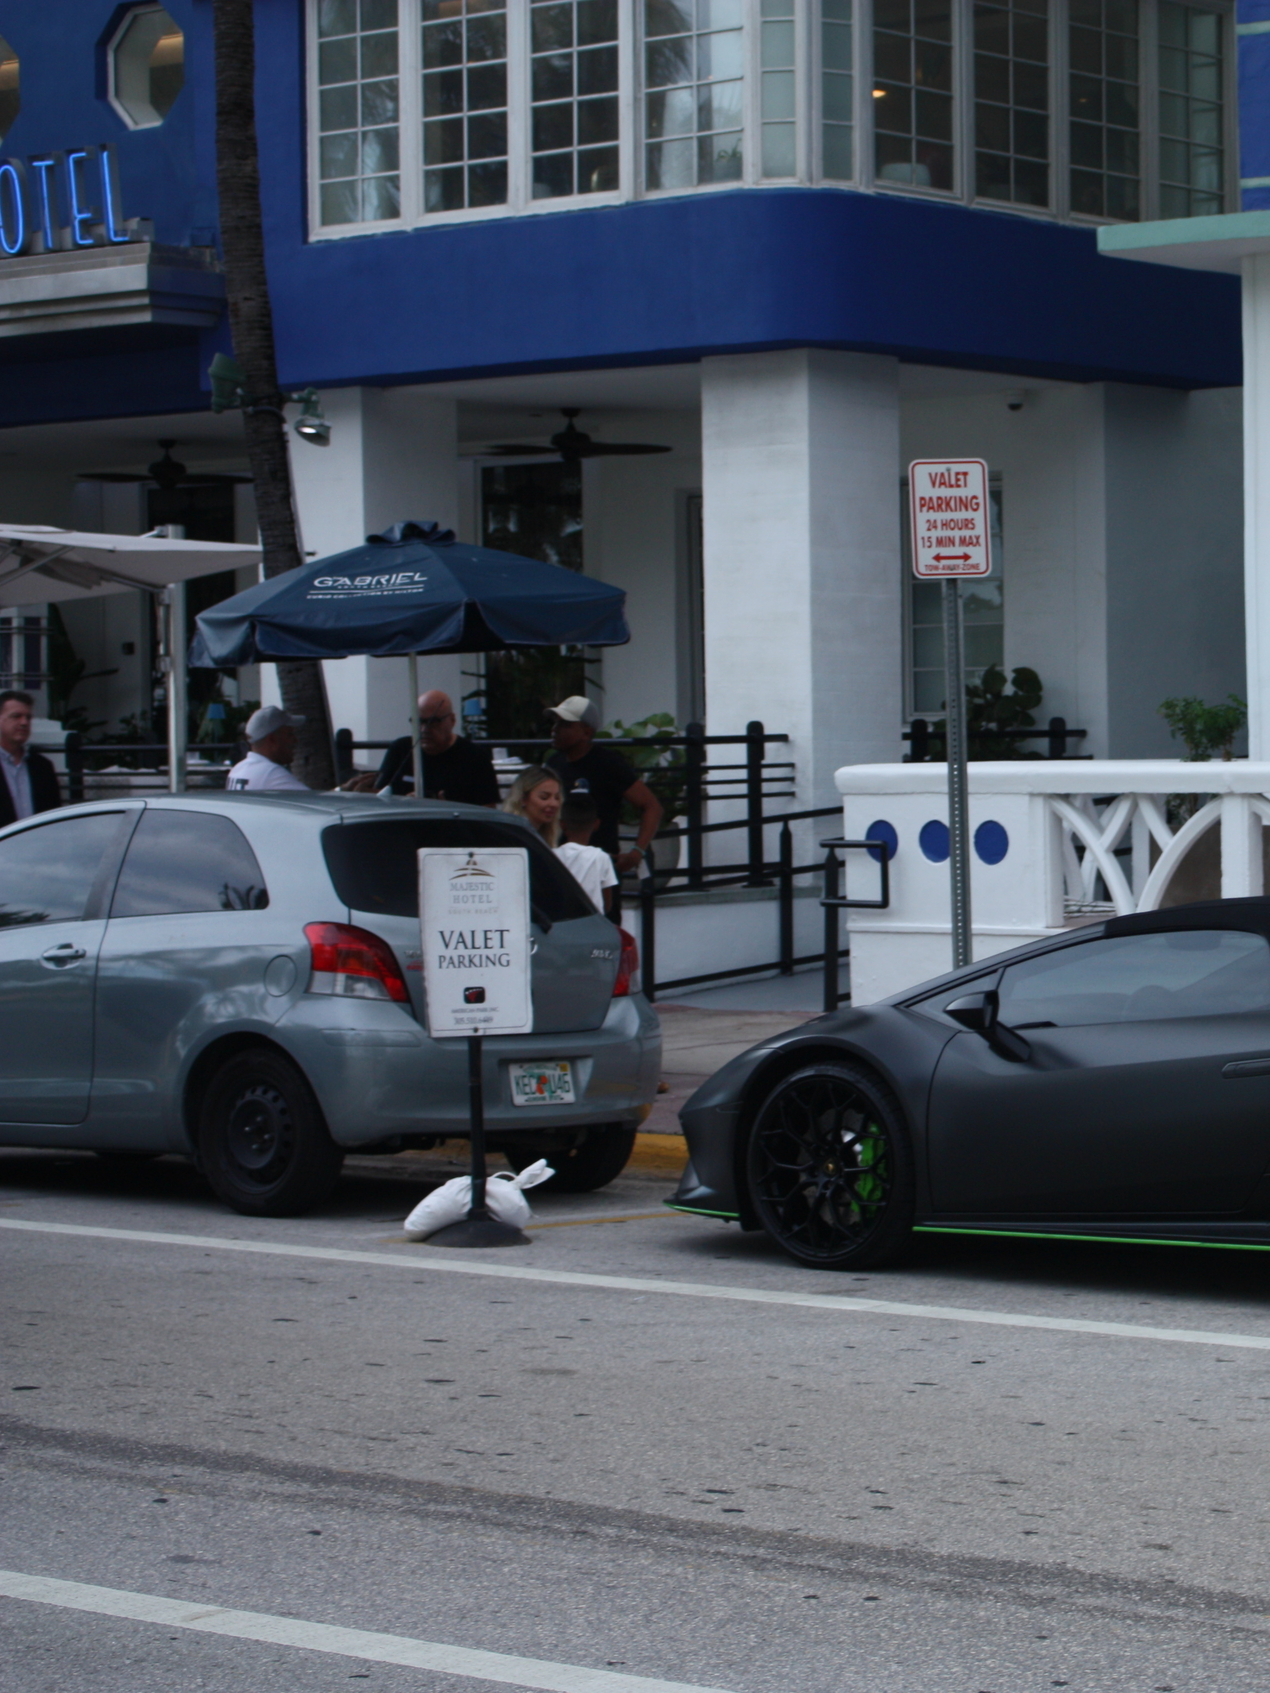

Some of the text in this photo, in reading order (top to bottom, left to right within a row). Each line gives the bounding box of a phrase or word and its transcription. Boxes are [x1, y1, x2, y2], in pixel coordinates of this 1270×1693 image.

[928, 472, 969, 488] VALET
[919, 495, 980, 513] PARKING
[926, 518, 975, 531] 24 HOURS
[921, 535, 981, 548] 15 MIN MAX
[313, 572, 428, 587] GABRIEL
[449, 882, 495, 892] MAJESTIC
[453, 894, 493, 904] HOTEL
[438, 929, 510, 950] VALET
[438, 953, 511, 969] PARKING
